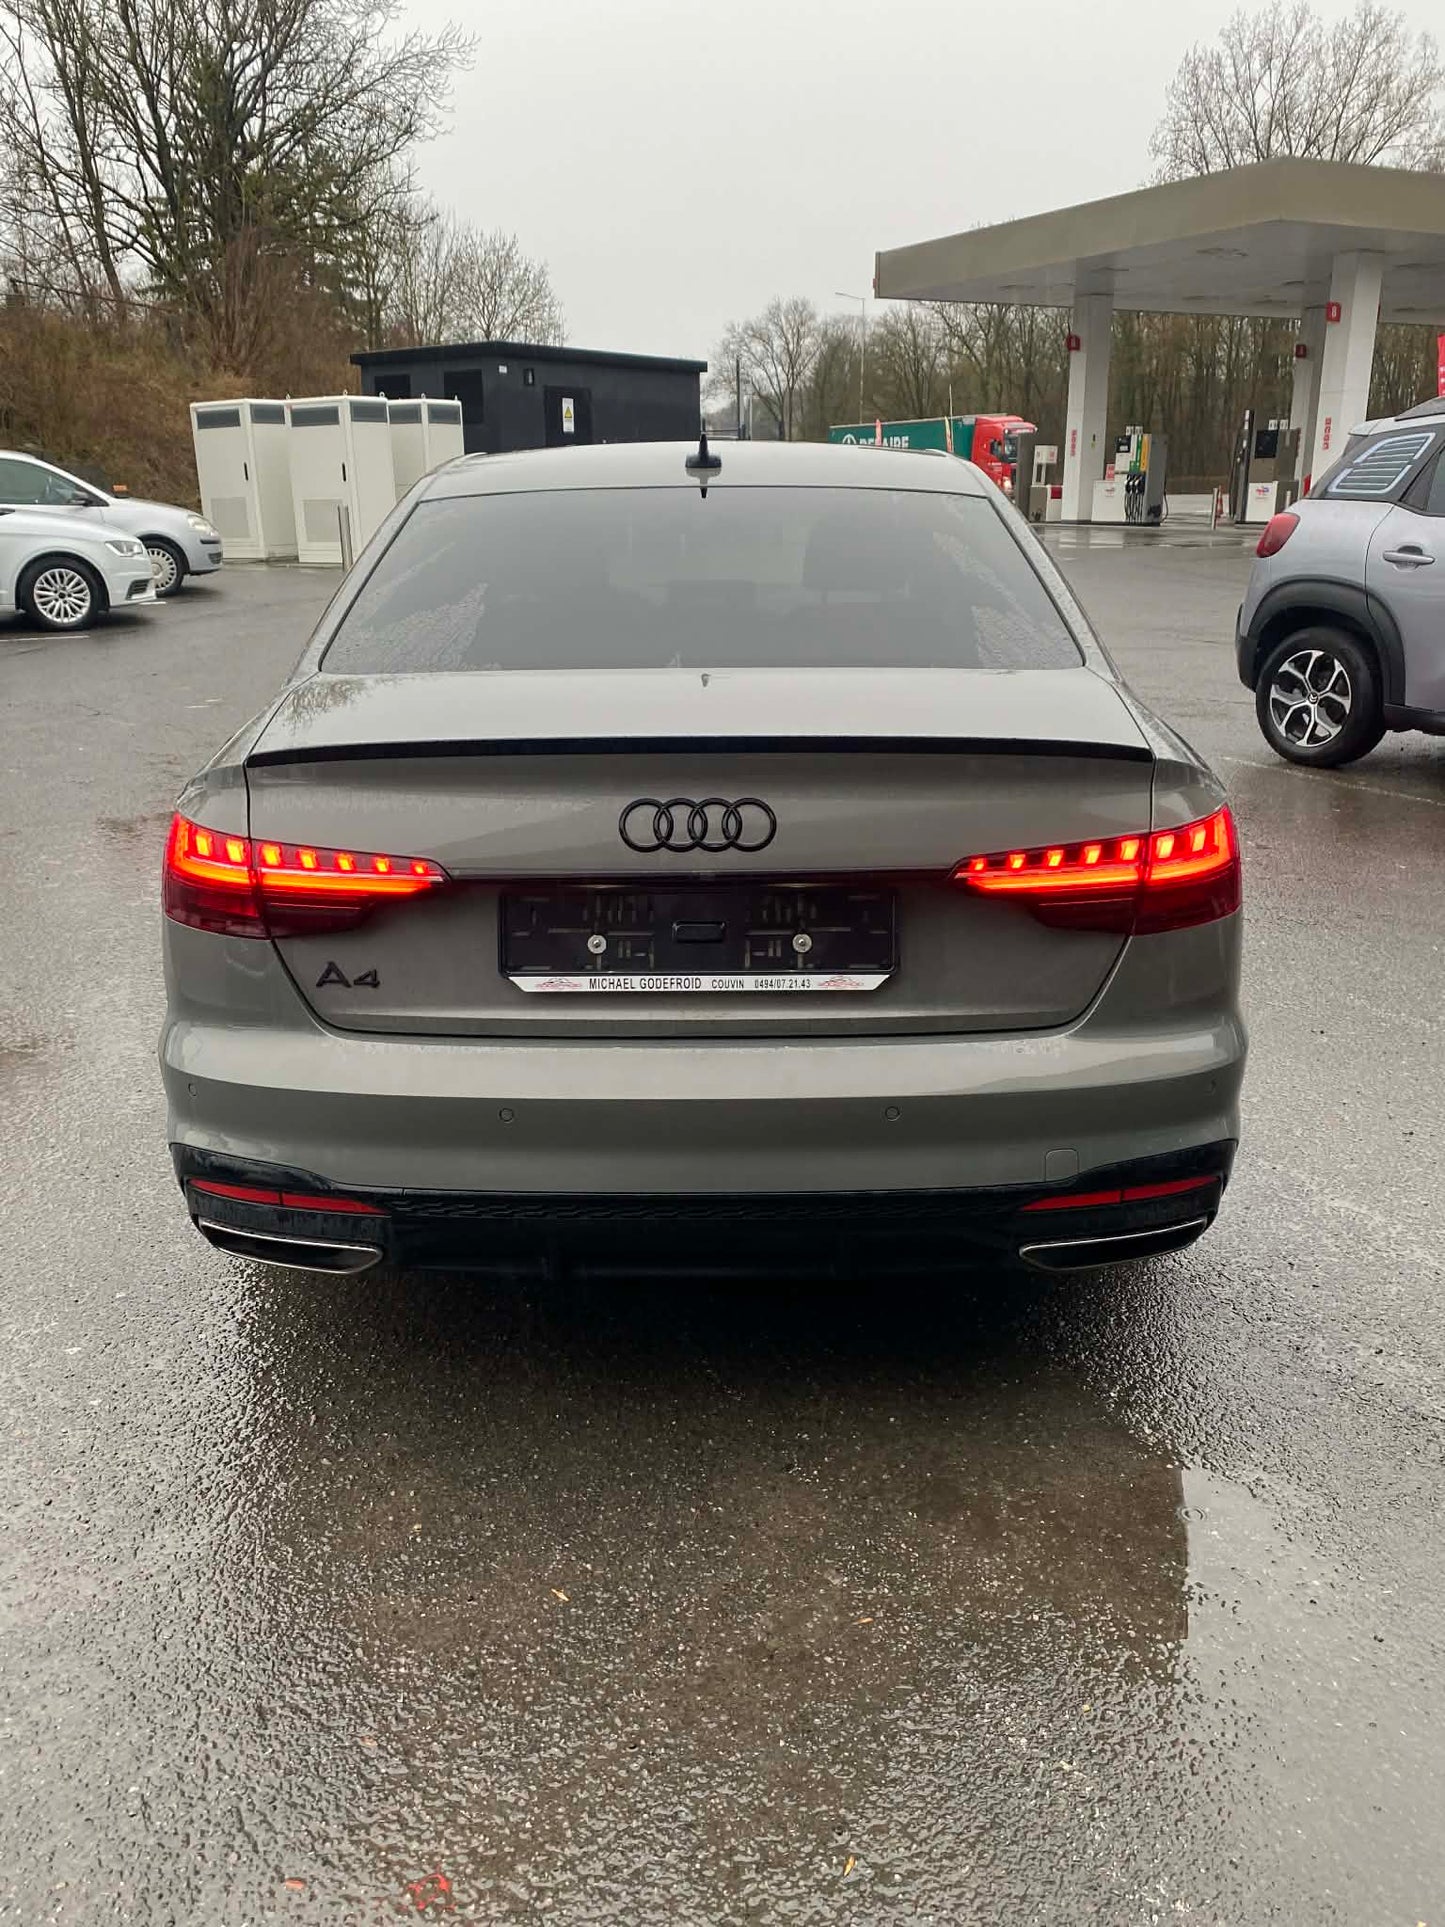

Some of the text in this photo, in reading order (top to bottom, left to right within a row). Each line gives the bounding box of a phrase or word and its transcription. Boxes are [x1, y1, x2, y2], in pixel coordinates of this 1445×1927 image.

[316, 961, 380, 988] A4
[589, 977, 811, 990] MICHAEL GODEFROID COUVIN 0494/07.21.43
